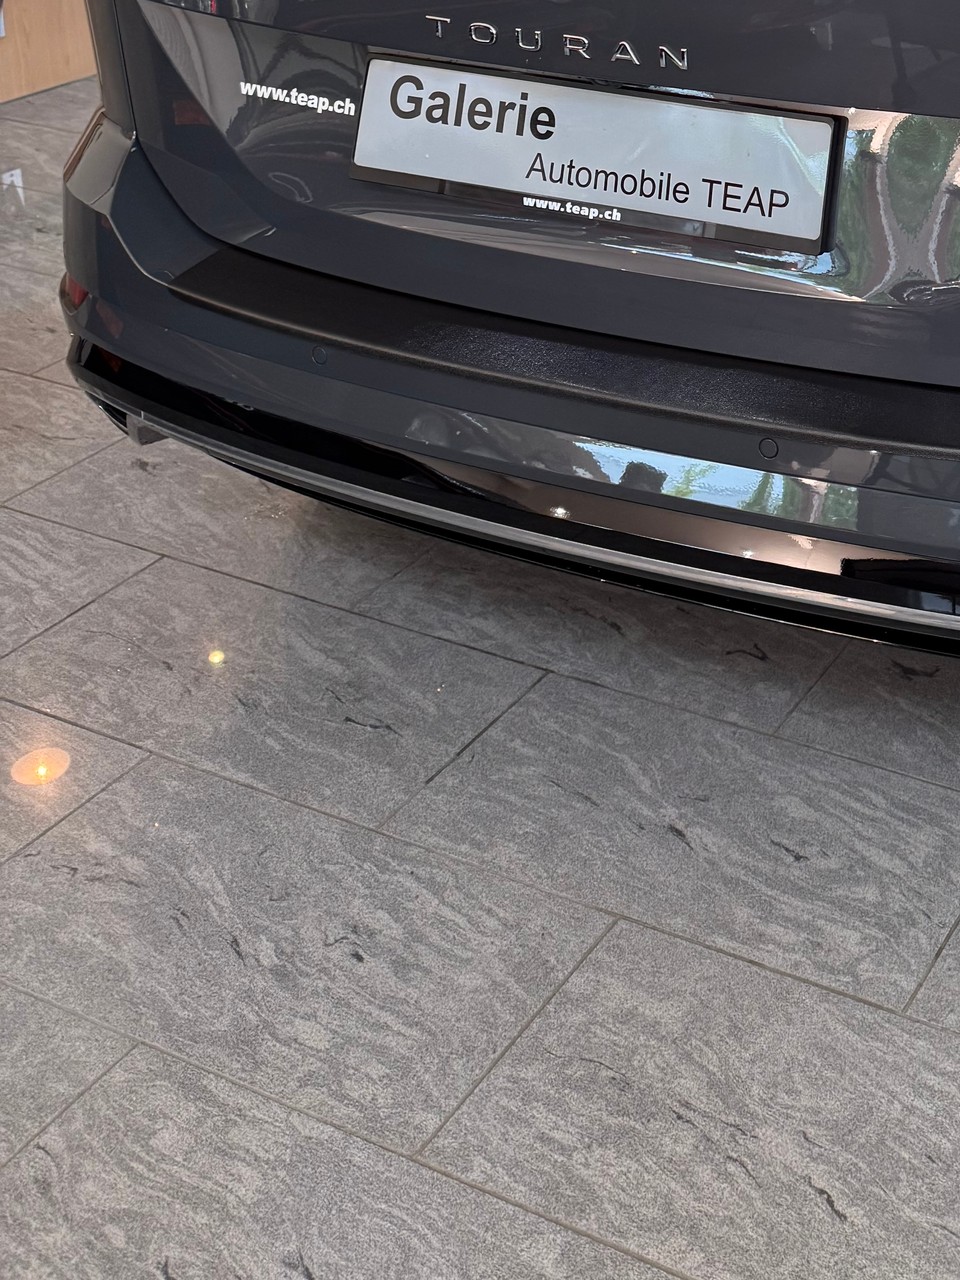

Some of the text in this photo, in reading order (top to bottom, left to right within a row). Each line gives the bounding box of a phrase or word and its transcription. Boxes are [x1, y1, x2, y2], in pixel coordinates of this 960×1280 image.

[425, 14, 689, 71] TOURAN
[239, 80, 356, 116] www.teap.ch
[389, 74, 557, 141] Galerie
[521, 195, 622, 222] www.teap.ch
[524, 151, 791, 219] Automobile TEAP
